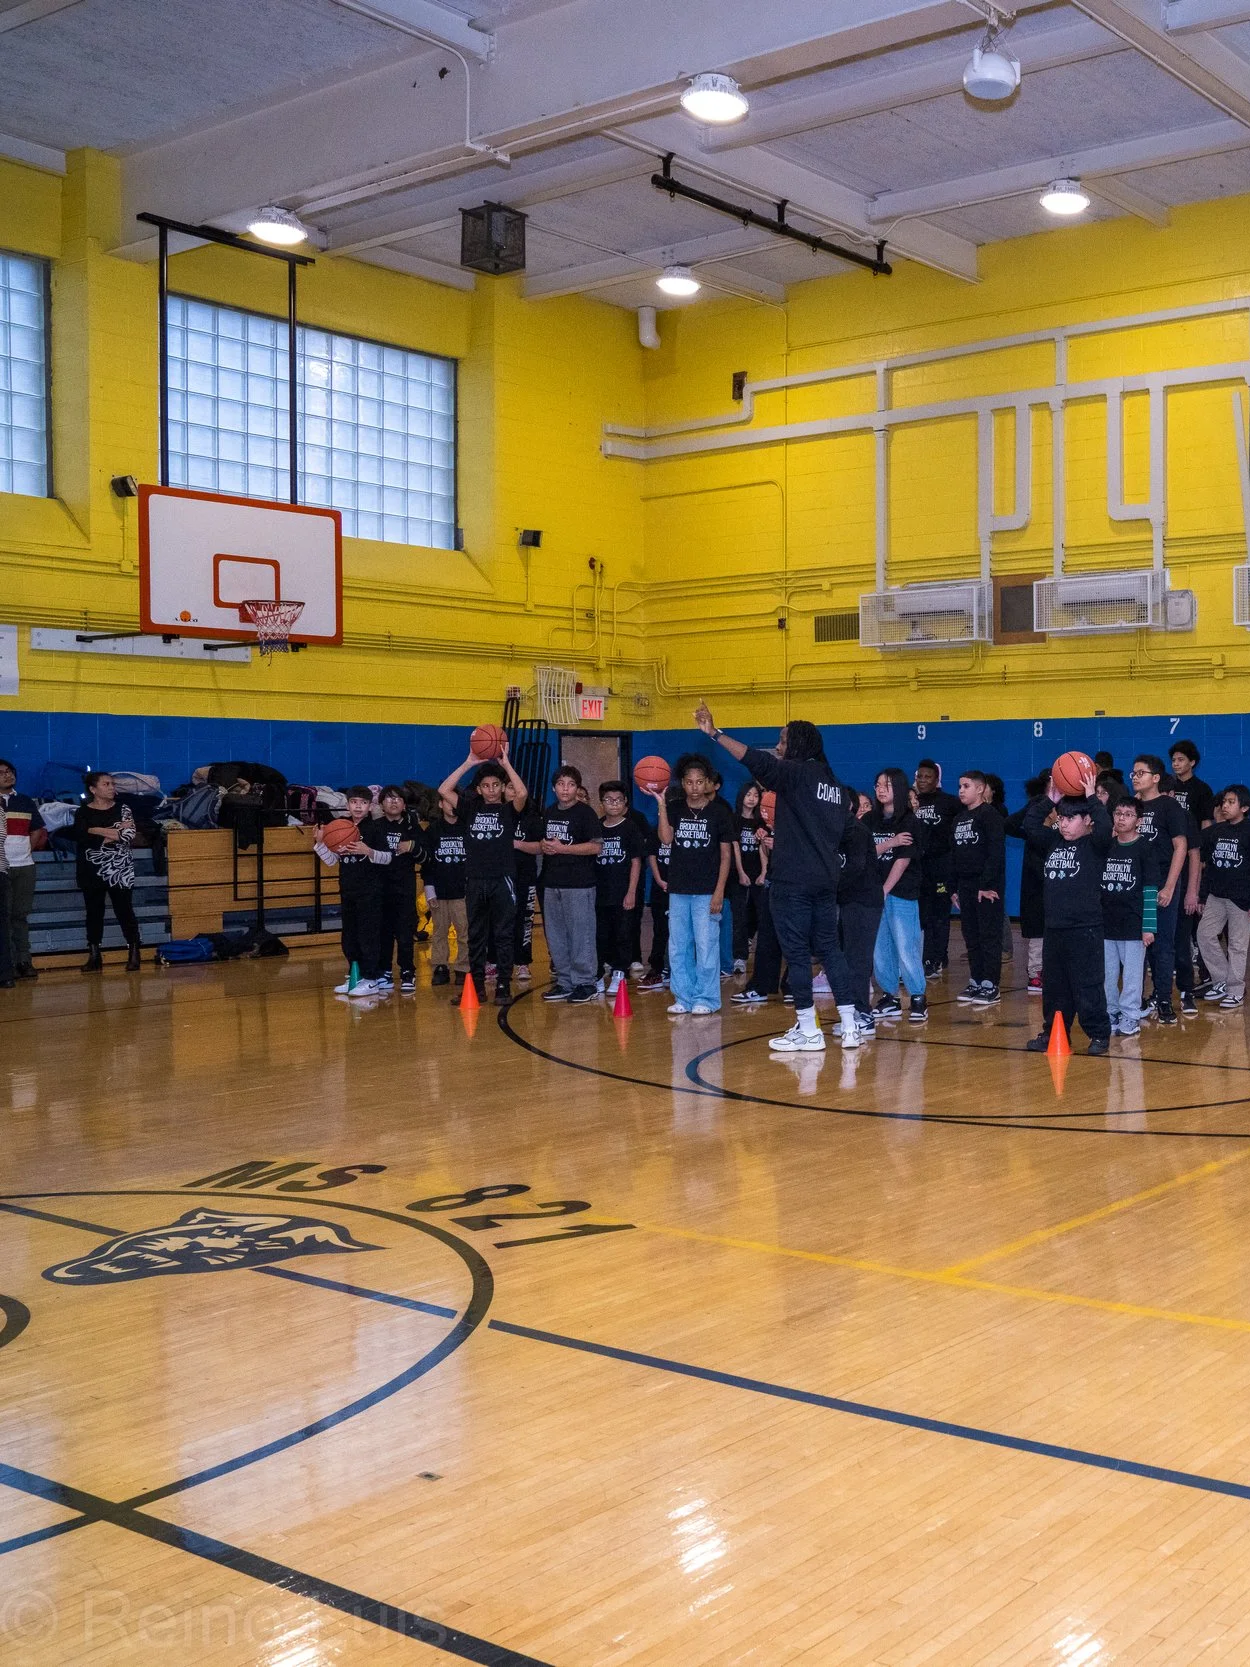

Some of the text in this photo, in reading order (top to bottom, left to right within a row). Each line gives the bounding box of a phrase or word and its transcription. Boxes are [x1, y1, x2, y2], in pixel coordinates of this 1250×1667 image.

[582, 699, 603, 719] EXIT
[1033, 721, 1043, 738] 8
[1169, 717, 1180, 735] 7
[917, 724, 926, 740] 9
[546, 823, 568, 833] BROOKLYN
[679, 822, 707, 832] BROOKLYN
[676, 829, 709, 840] BASKETBALL
[440, 841, 464, 849] BROOKLYN
[437, 848, 467, 856] BASKETBALL
[1049, 850, 1076, 861] BROKLYN
[1214, 850, 1239, 861] BSKETBALL
[1106, 862, 1132, 873] BROOKLYN
[181, 1160, 637, 1250] MS 821
